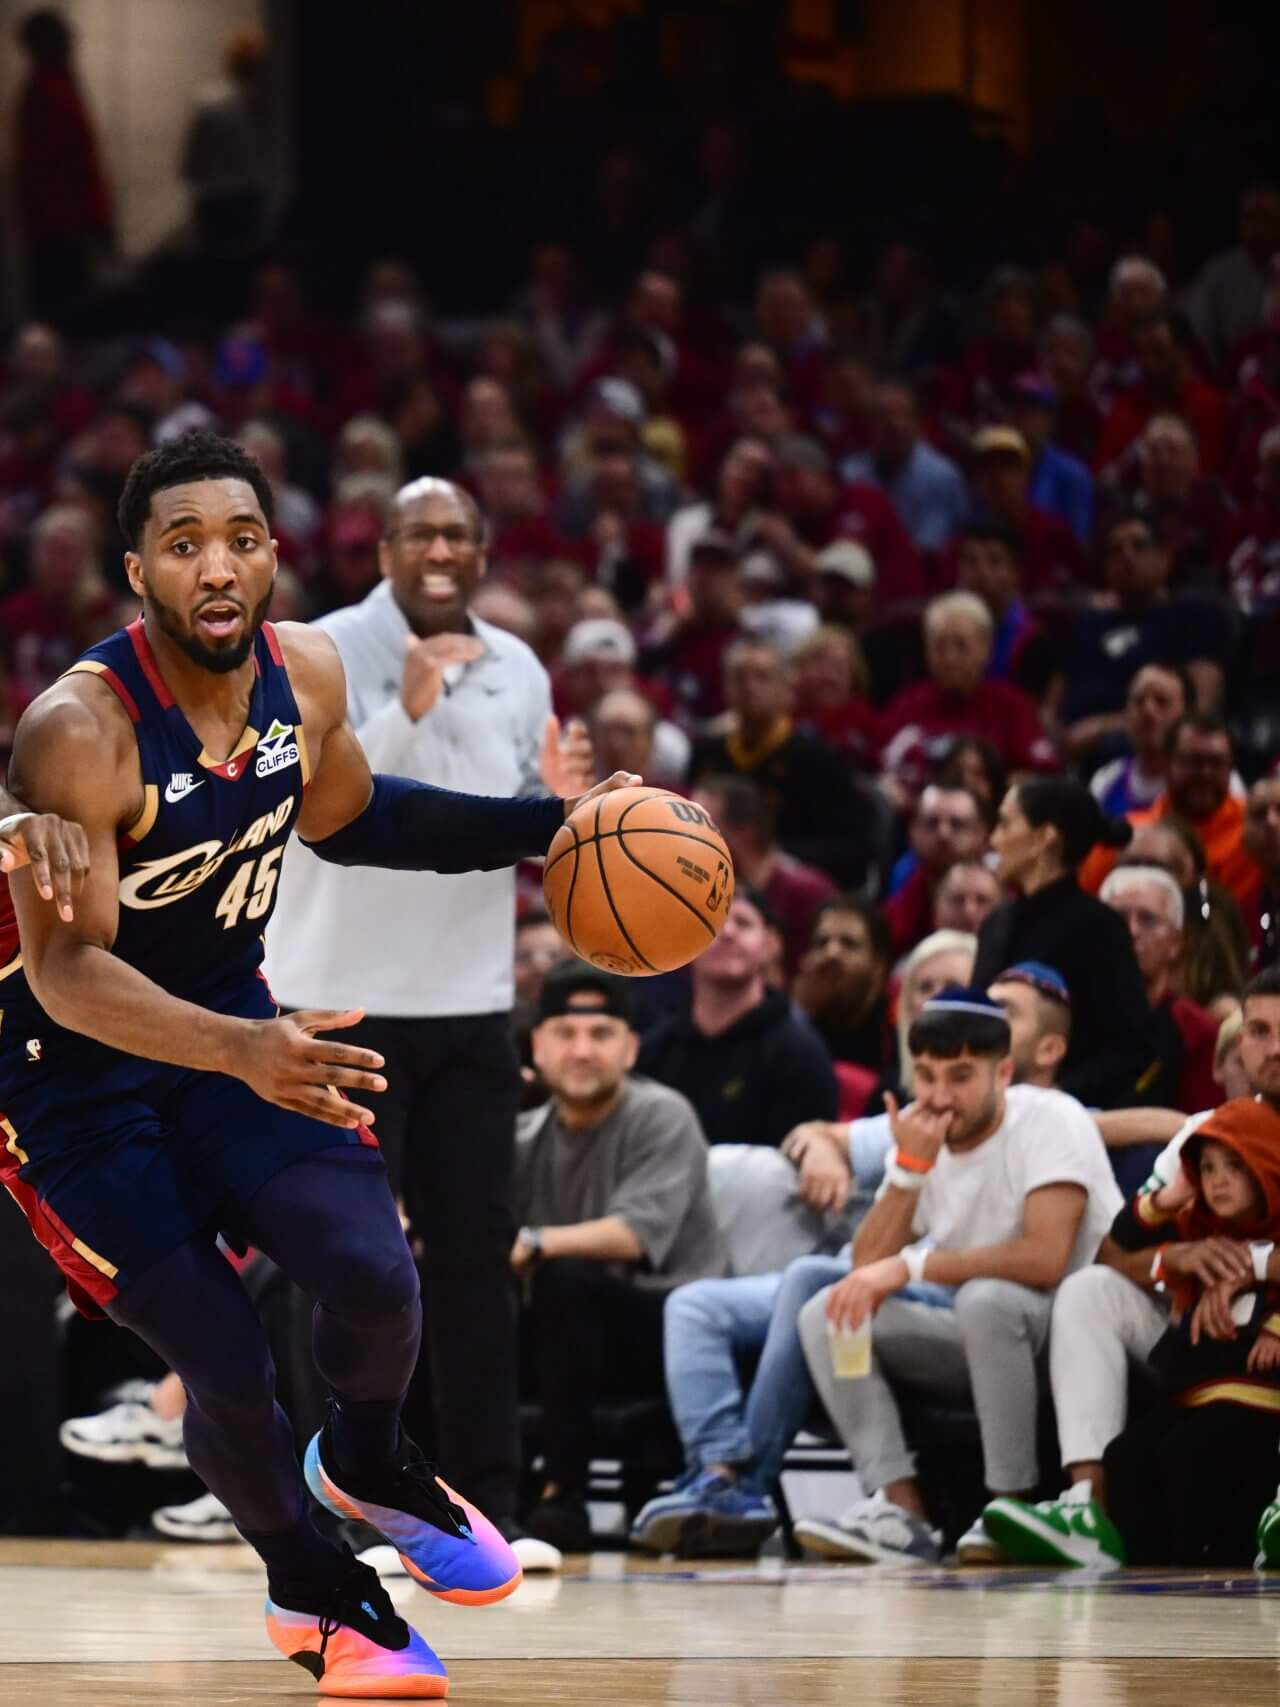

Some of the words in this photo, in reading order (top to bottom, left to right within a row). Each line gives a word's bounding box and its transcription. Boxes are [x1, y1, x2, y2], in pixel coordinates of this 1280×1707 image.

[227, 763, 238, 777] C
[257, 748, 298, 773] CLIFFS
[171, 773, 194, 790] NIKE
[119, 796, 295, 910] CLEVAND
[215, 845, 285, 930] 45
